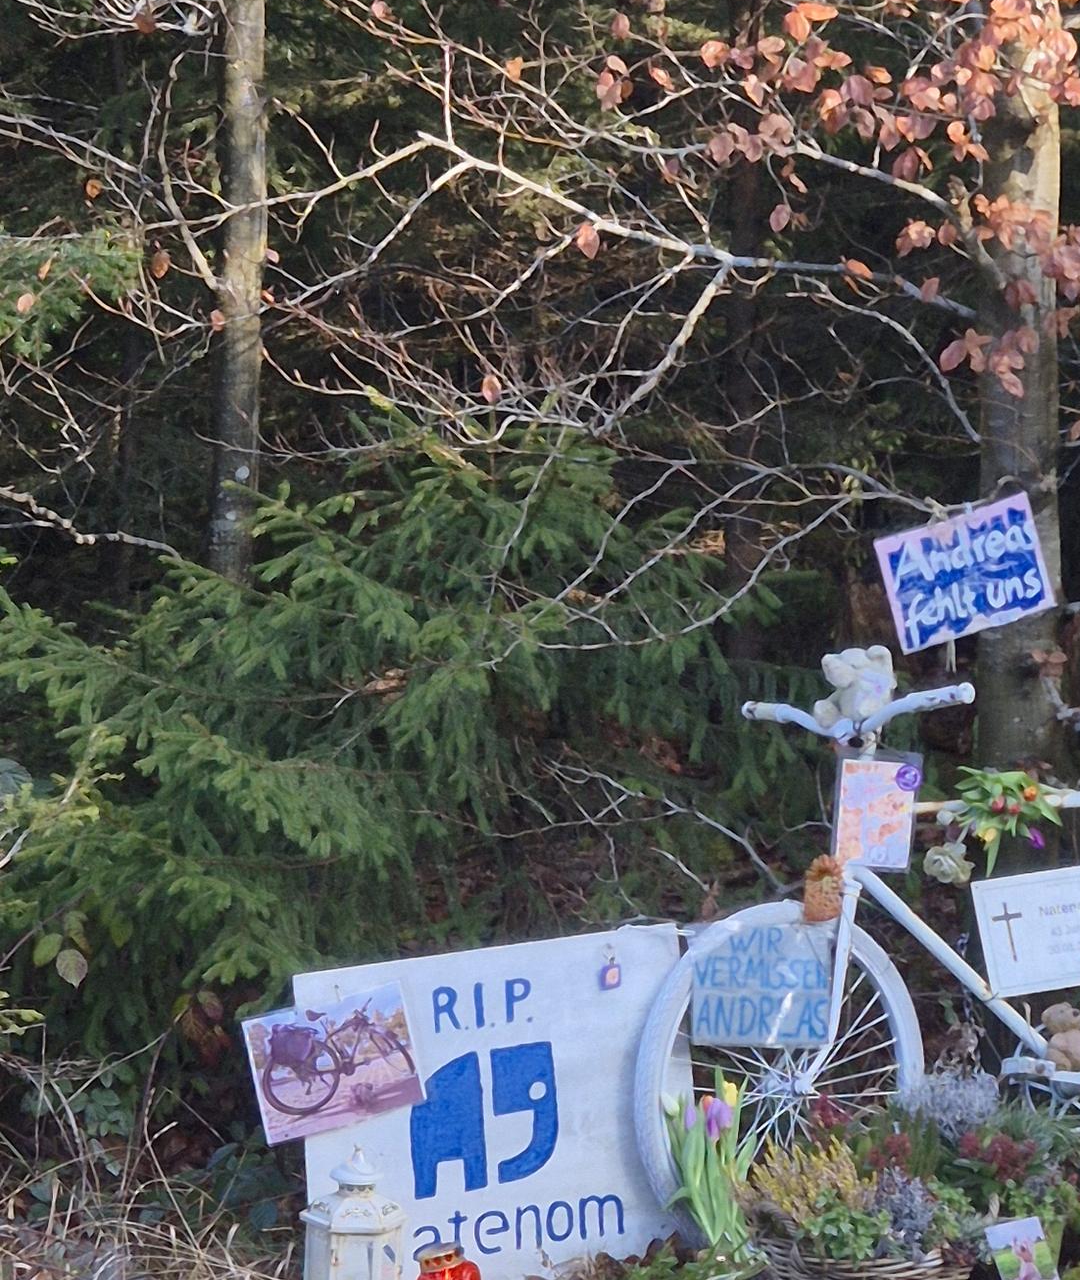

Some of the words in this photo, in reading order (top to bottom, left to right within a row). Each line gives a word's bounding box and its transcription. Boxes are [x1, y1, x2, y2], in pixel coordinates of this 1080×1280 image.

[893, 521, 1037, 593] Andreas
[905, 582, 978, 649] fehlt
[985, 567, 1042, 609] uns
[729, 926, 784, 955] WIR
[432, 977, 535, 1034] R.I.P.
